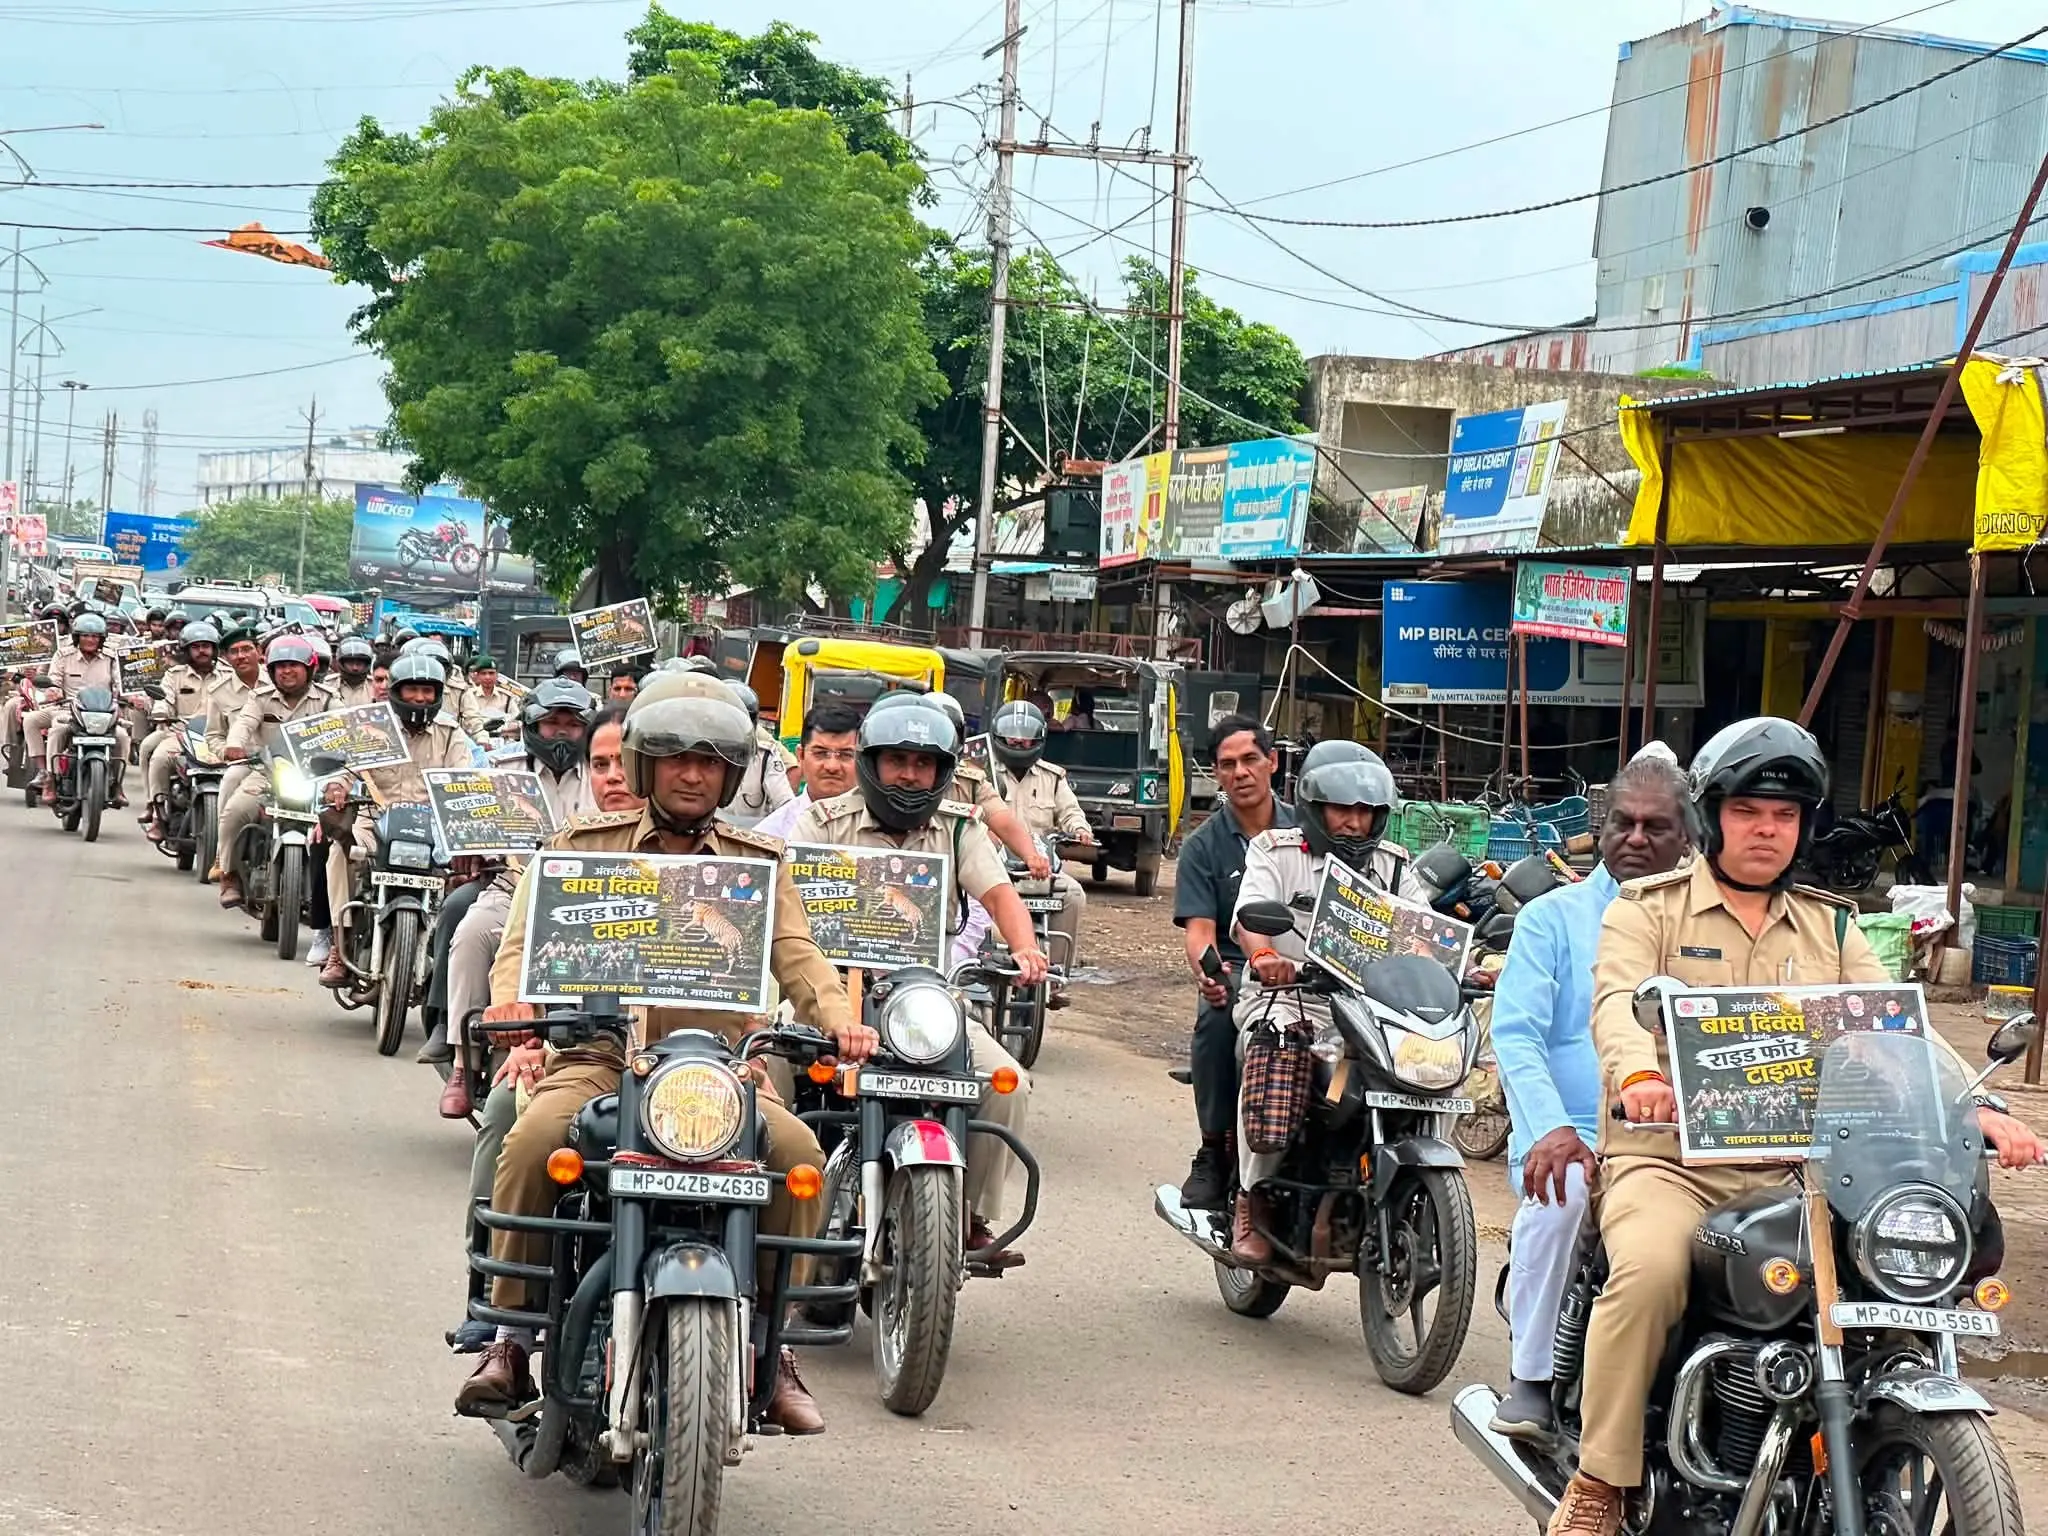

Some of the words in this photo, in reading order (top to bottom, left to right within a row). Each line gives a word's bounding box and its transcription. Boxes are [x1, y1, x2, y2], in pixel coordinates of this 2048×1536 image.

[1482, 451, 1511, 470] CEMENT
[366, 500, 414, 518] WICKED
[1544, 574, 1561, 598] भारत
[1400, 628, 1424, 641] MP
[1429, 628, 1478, 641] BIRLA
[1433, 644, 1463, 659] सीमेंट
[1467, 644, 1476, 659] से
[1480, 648, 1496, 659] घर
[1432, 693, 1446, 702] M/s
[1446, 693, 1474, 702] MITTAL
[1476, 694, 1507, 702] TRADER
[817, 863, 857, 880] दिवस
[561, 877, 602, 895] बाघ
[608, 877, 660, 896] दिवस
[822, 883, 850, 896] फॉर
[562, 906, 607, 922] राइड
[612, 902, 648, 918] फॉर
[806, 898, 858, 914] टाइगर
[1336, 884, 1362, 906] बाघ
[1361, 899, 1394, 924] दिवस
[591, 918, 660, 940] टाइगर
[1349, 927, 1390, 951] टाइगर
[1698, 1015, 1747, 1035] बाघ
[1750, 1014, 1806, 1034] दिवस
[1708, 1047, 1757, 1068] राइड
[1760, 1040, 1800, 1061] फॉर
[1743, 1058, 1816, 1086] टाइगर
[876, 1076, 894, 1088] MP
[900, 1078, 935, 1093] 04VC
[942, 1081, 976, 1097] 9112
[1382, 1094, 1397, 1106] MP
[1724, 1134, 1767, 1145] सामान्य
[1770, 1135, 1788, 1144] वन
[632, 1174, 655, 1190] MP
[664, 1175, 710, 1193] 04ZB
[720, 1178, 766, 1197] 4636
[1856, 1307, 1880, 1323] MP
[1890, 1308, 1937, 1327] 04YD
[1946, 1314, 1994, 1332] 5961
